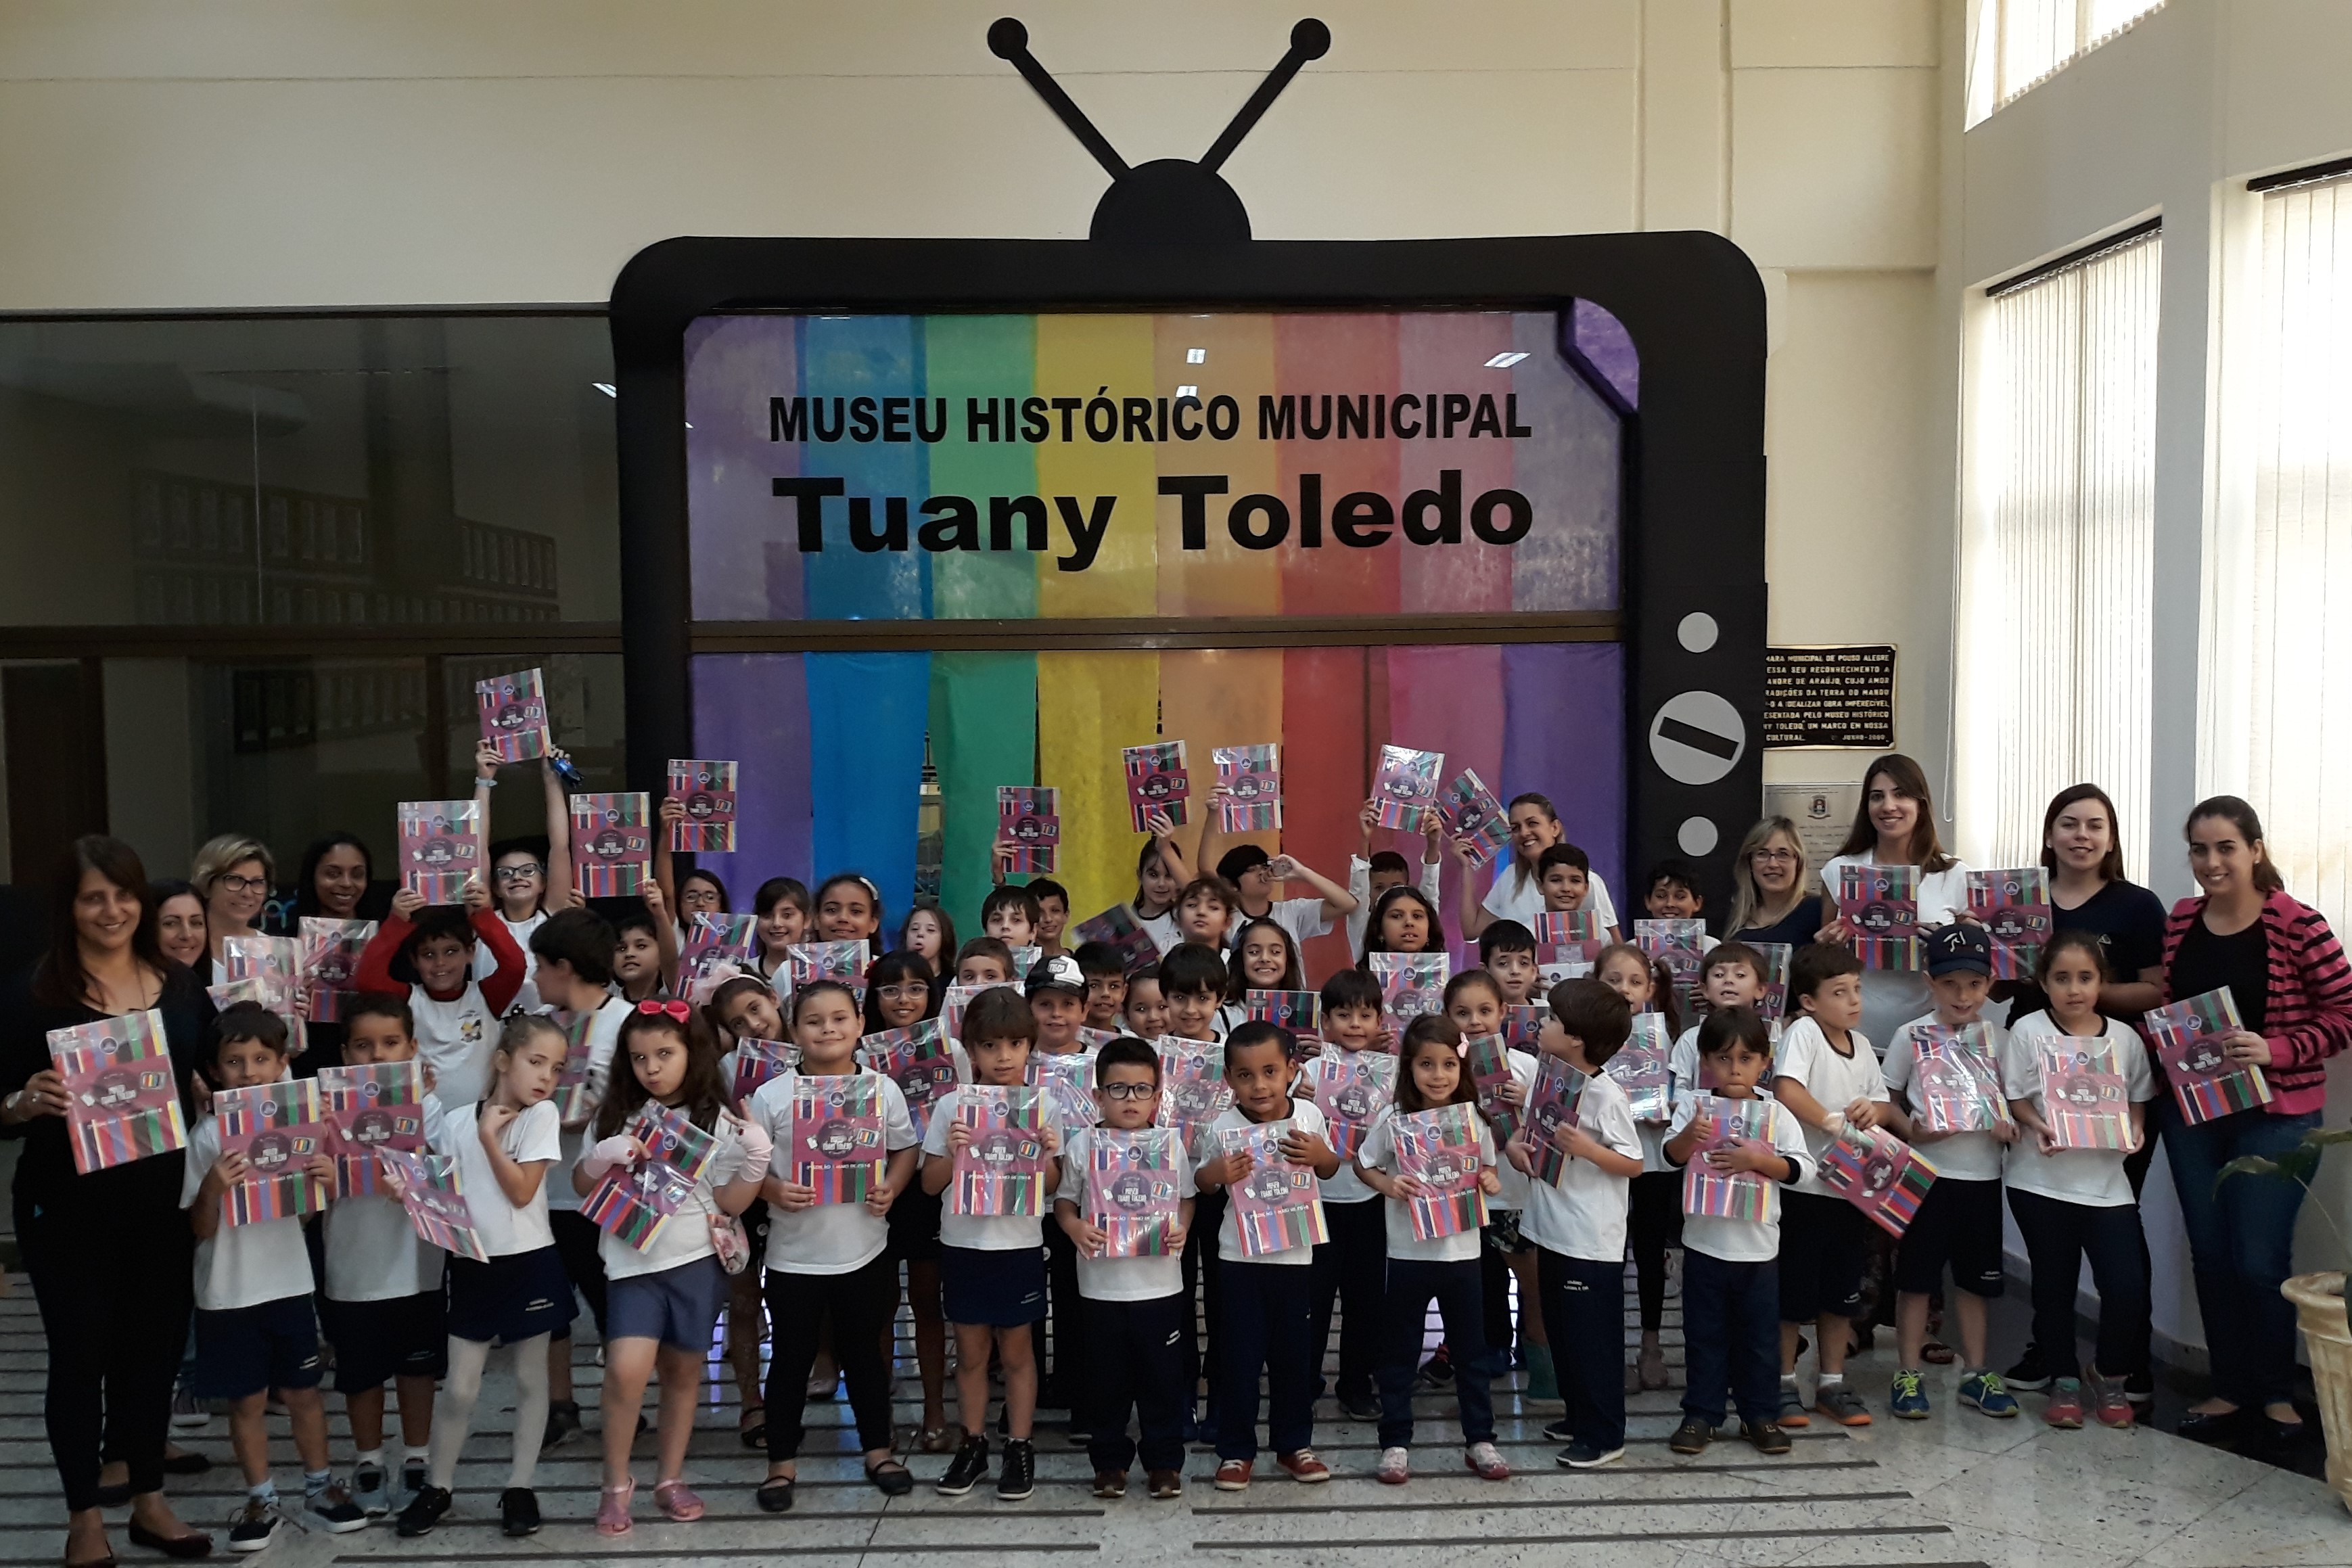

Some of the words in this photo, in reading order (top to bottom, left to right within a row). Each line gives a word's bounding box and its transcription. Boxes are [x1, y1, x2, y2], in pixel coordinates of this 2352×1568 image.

[769, 396, 947, 442] MUSEU
[967, 386, 1239, 442] HISTÓRICO
[1258, 393, 1532, 440] MUNICIPAL
[772, 477, 1118, 572] Tuany
[1157, 469, 1534, 550] Toledo
[1826, 654, 1836, 662] DE
[1810, 666, 1880, 674] RECONHECIMENTO
[1795, 677, 1806, 685] DE
